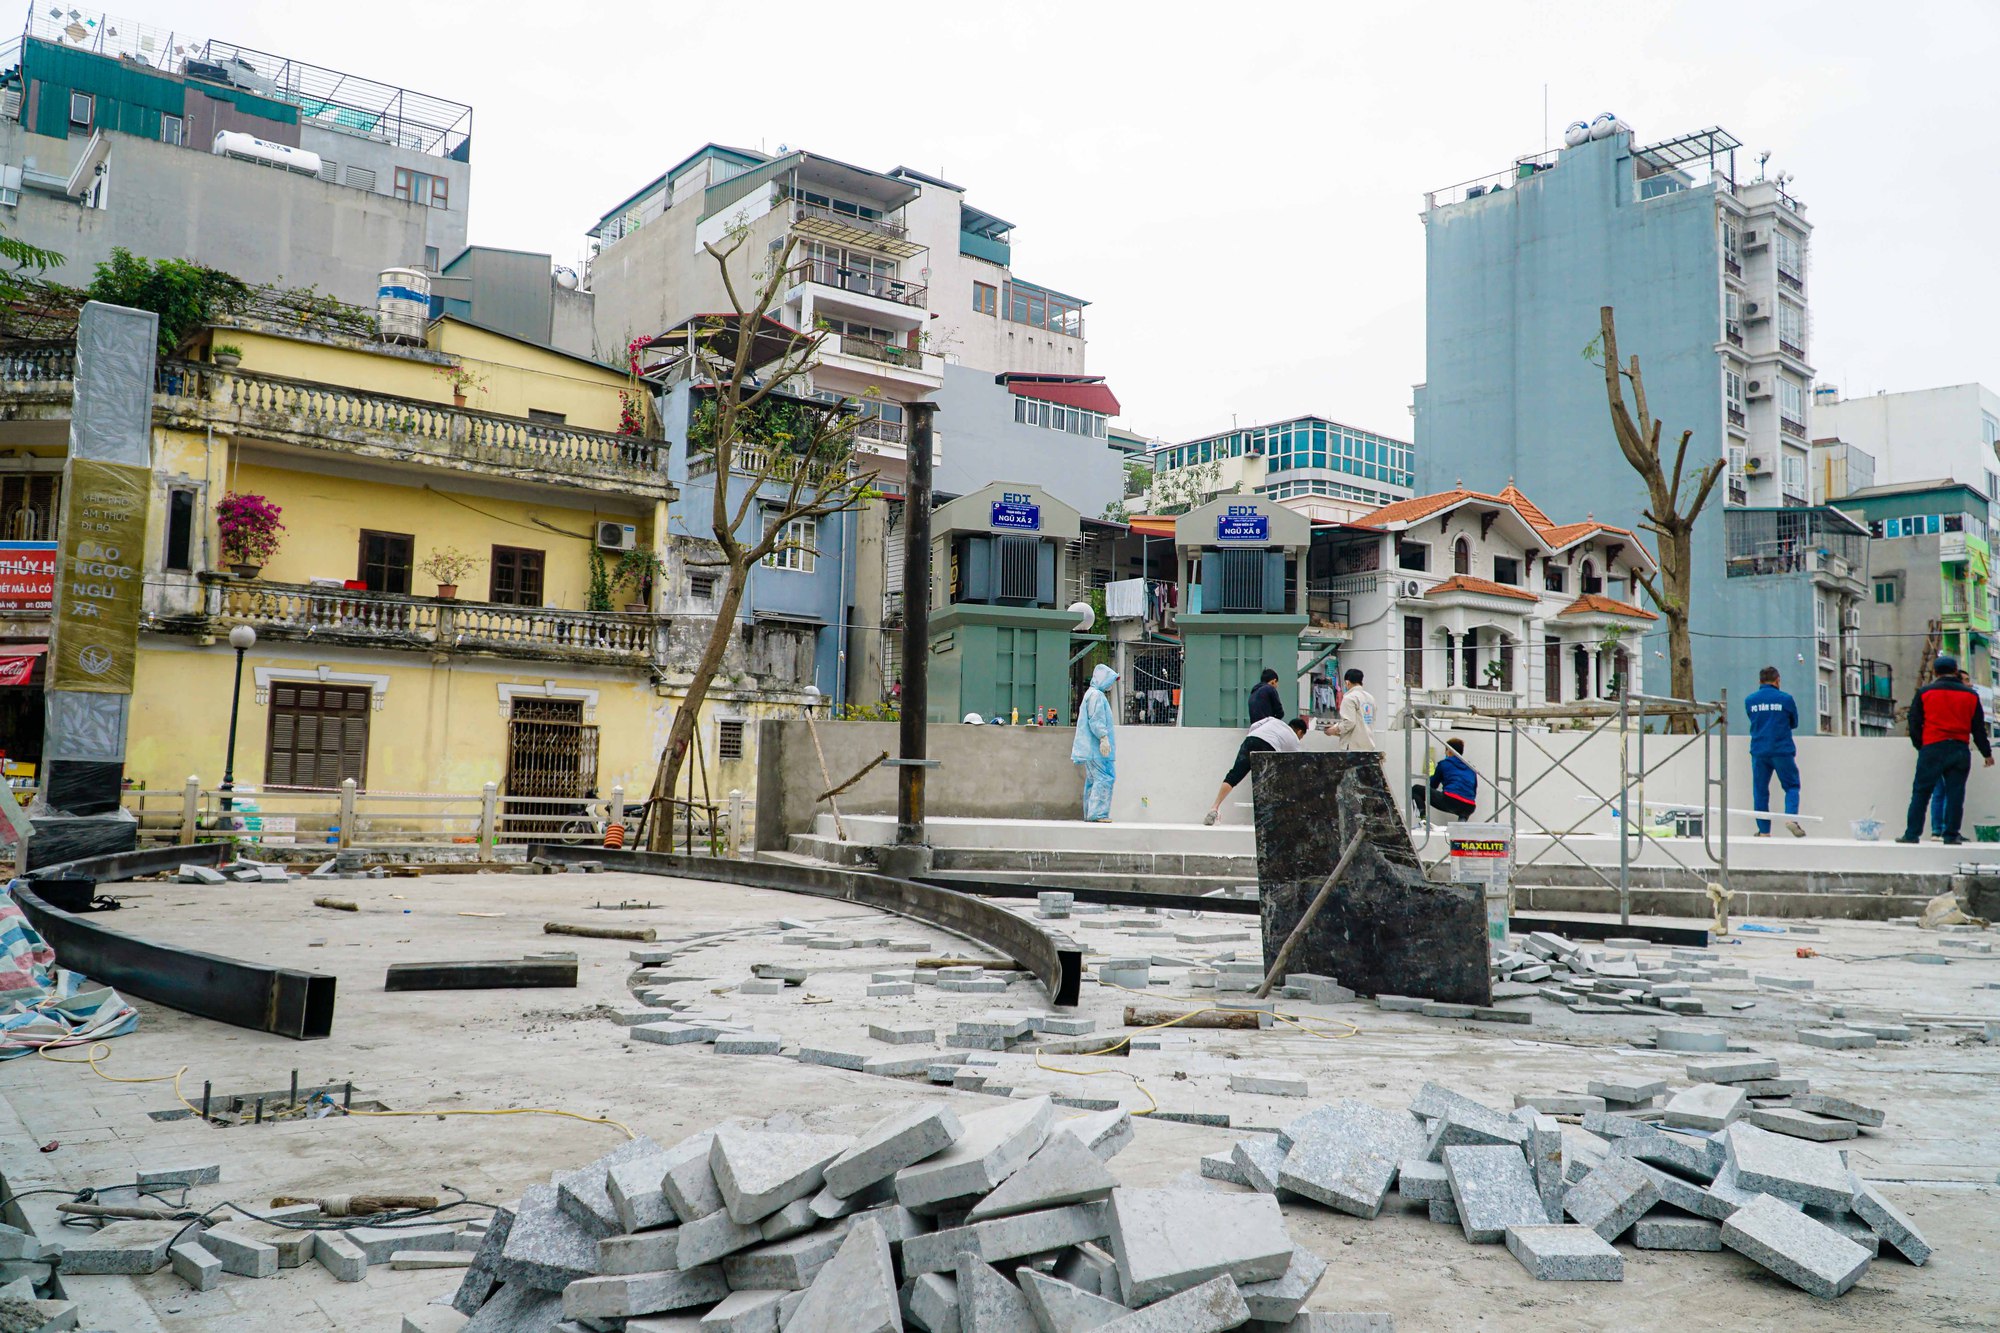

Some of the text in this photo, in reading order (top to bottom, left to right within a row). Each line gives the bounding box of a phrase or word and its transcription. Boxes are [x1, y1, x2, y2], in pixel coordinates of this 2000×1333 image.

[1224, 527, 1241, 535] NGŨ
[1243, 526, 1254, 535] XÃ
[0, 556, 39, 576] THỦY
[11, 582, 25, 593] MÃ
[26, 582, 37, 593] LÀ
[39, 582, 52, 594] CÓ
[1461, 842, 1504, 851] MAXILITE
